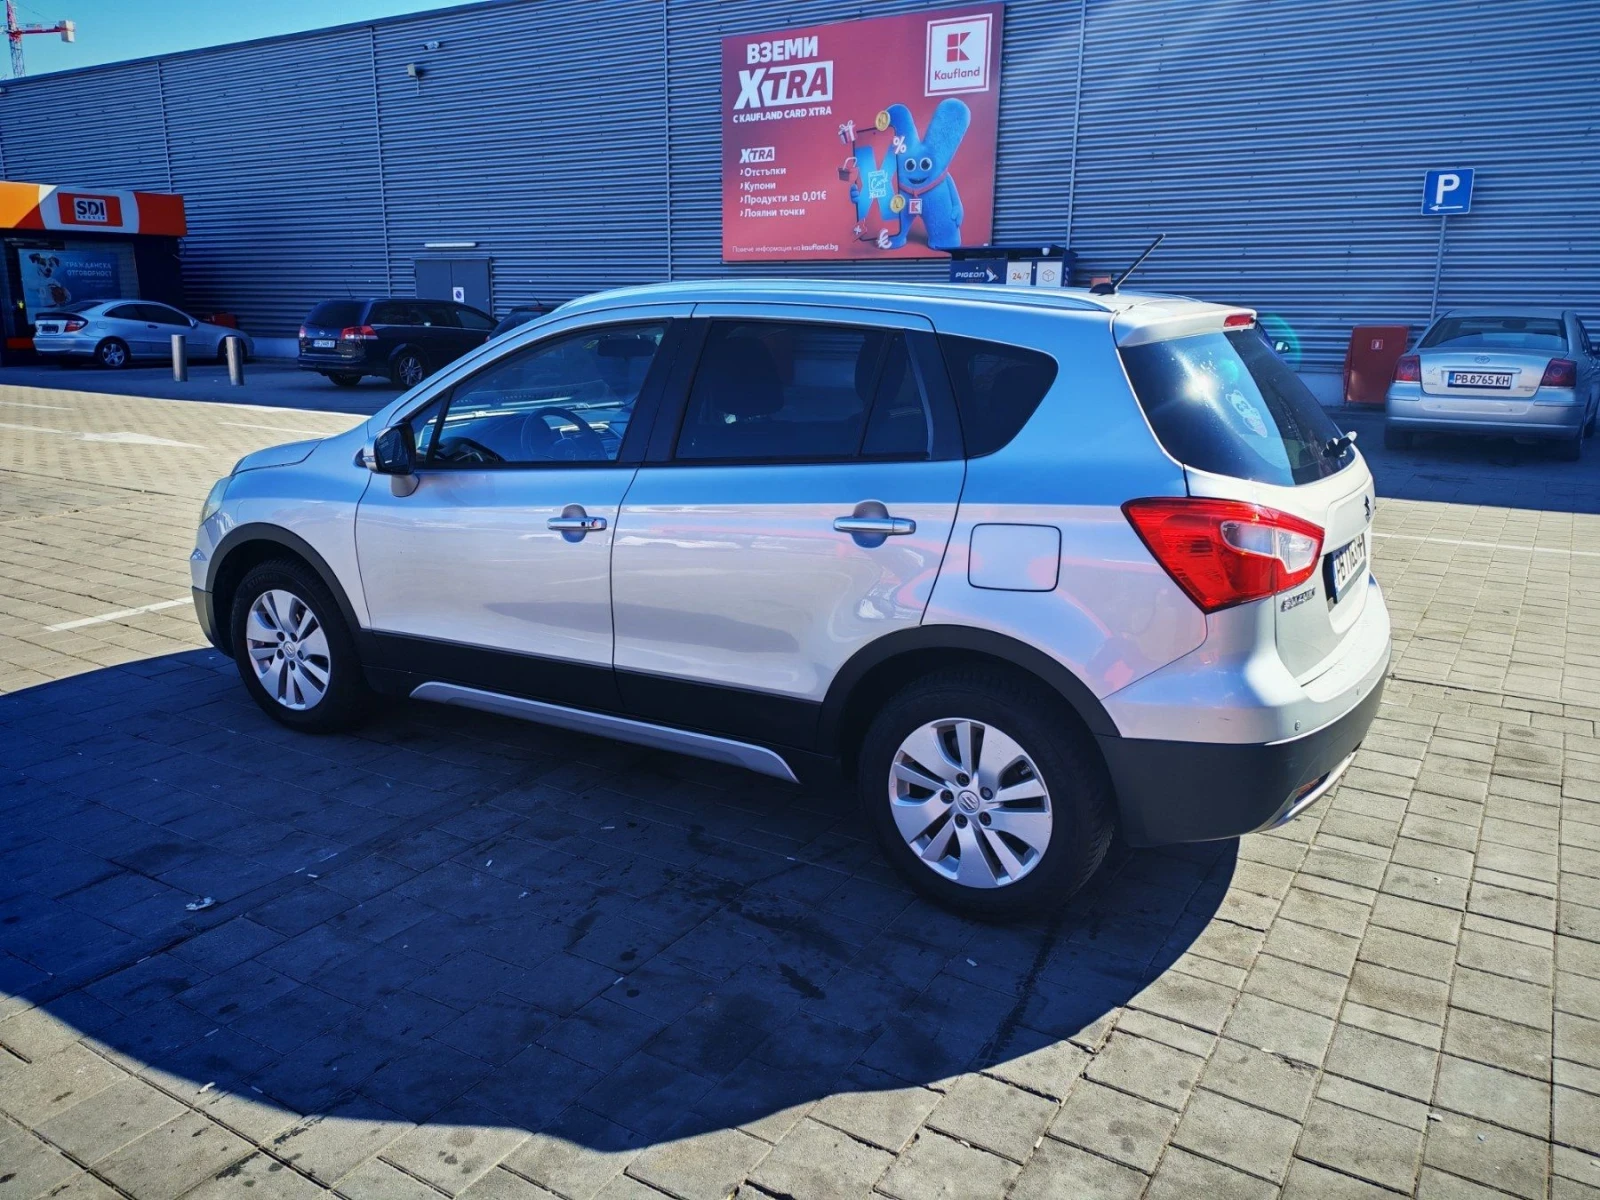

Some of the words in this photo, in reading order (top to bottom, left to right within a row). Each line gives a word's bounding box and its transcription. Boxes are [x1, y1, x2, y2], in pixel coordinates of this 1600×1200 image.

[747, 35, 818, 65] ВЗЕМИ
[934, 66, 980, 81] Kaufland
[733, 65, 830, 110] XTRA
[739, 111, 783, 123] KAUFLAND
[784, 108, 807, 119] CARD
[808, 106, 832, 117] XTRA
[739, 147, 774, 163] XTRA
[744, 167, 787, 177] Отстъпки
[744, 181, 776, 192] Купони
[1435, 173, 1460, 204] P
[744, 194, 787, 205] Продукти
[789, 194, 800, 202] за
[802, 190, 827, 202] 0,01€
[76, 200, 105, 216] SDI
[744, 208, 777, 218] Лоялни
[779, 208, 805, 216] точки
[801, 243, 839, 252] kaufland.bg
[1012, 272, 1031, 280] 24/7
[1454, 374, 1468, 384] PB
[1469, 374, 1495, 385] 8765
[1495, 375, 1510, 386] KH
